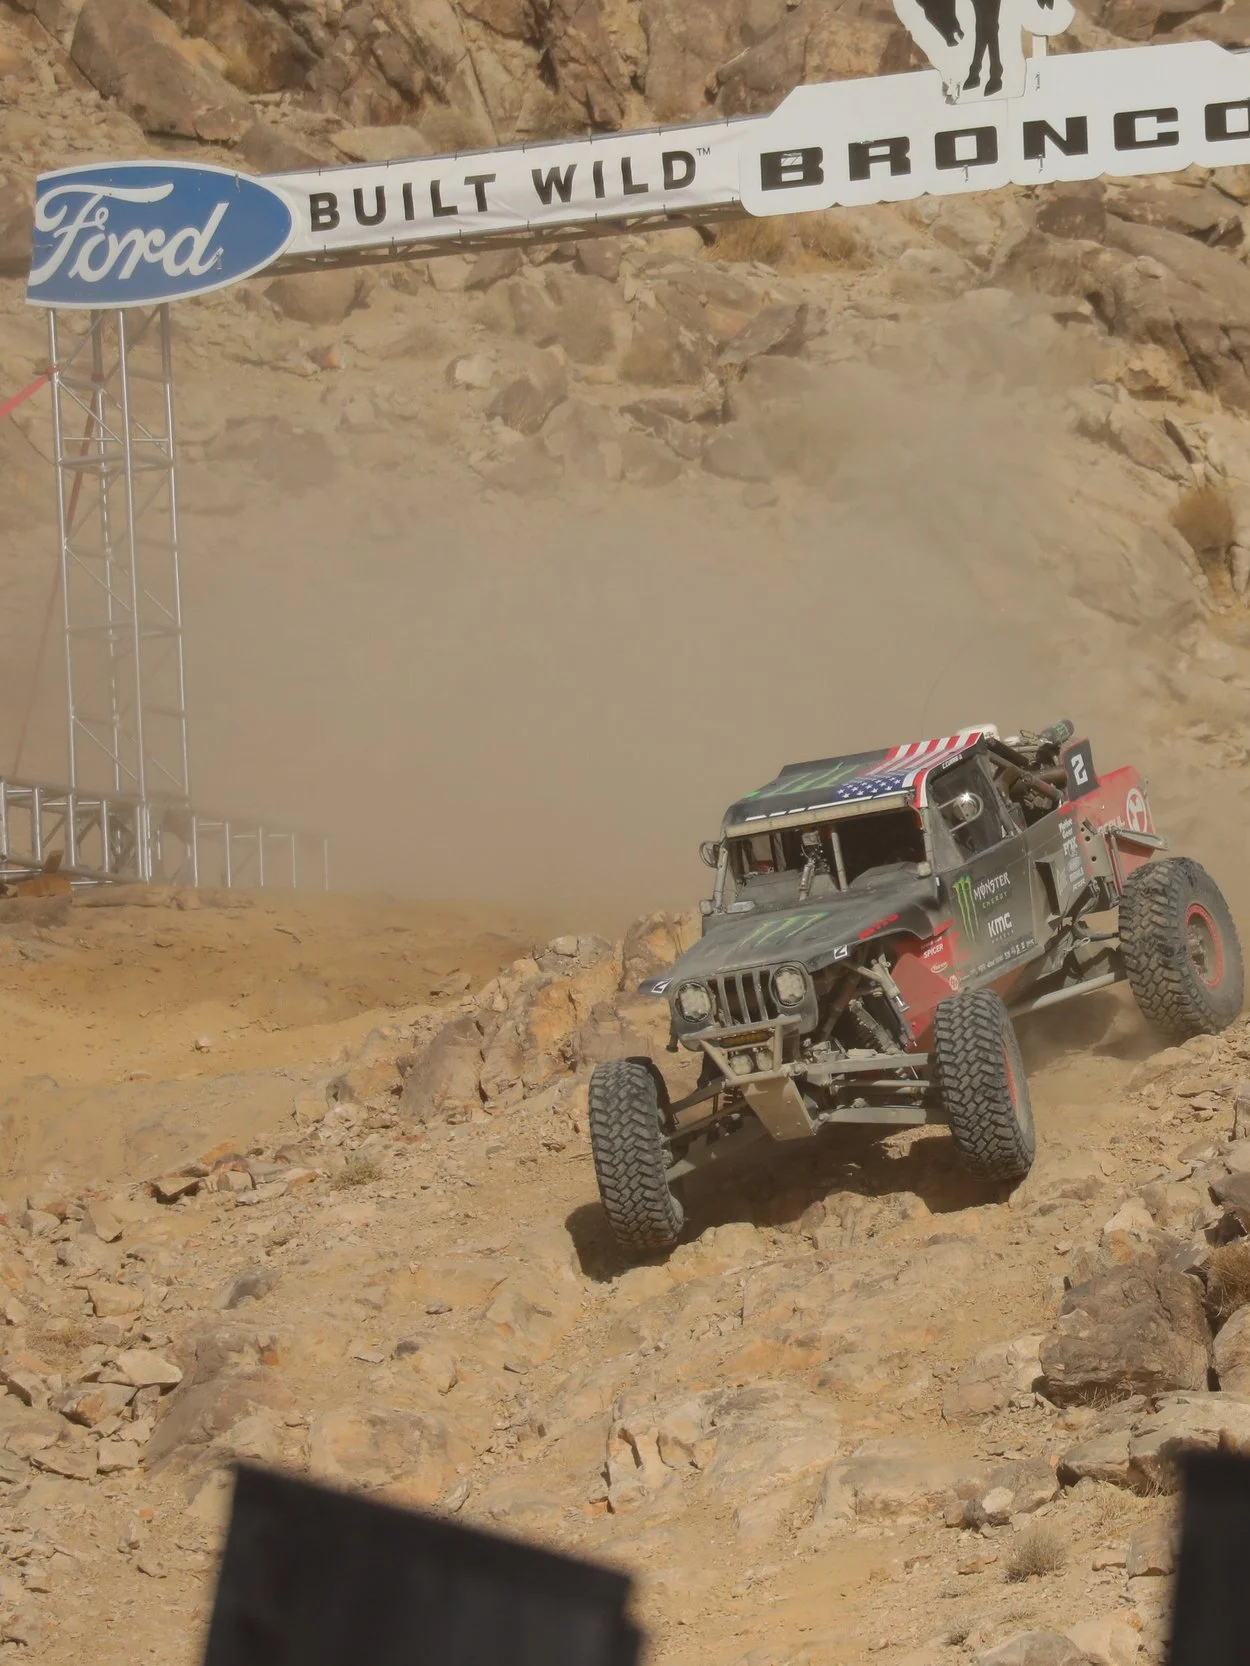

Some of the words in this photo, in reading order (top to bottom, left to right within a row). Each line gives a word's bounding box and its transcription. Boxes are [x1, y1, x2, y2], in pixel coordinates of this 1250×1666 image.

[309, 173, 497, 233] BUILT
[28, 183, 230, 287] Ford
[1070, 753, 1089, 786] 2
[973, 871, 1011, 901] MONSTER
[987, 911, 1013, 938] KMC
[923, 943, 944, 959] SPICER
